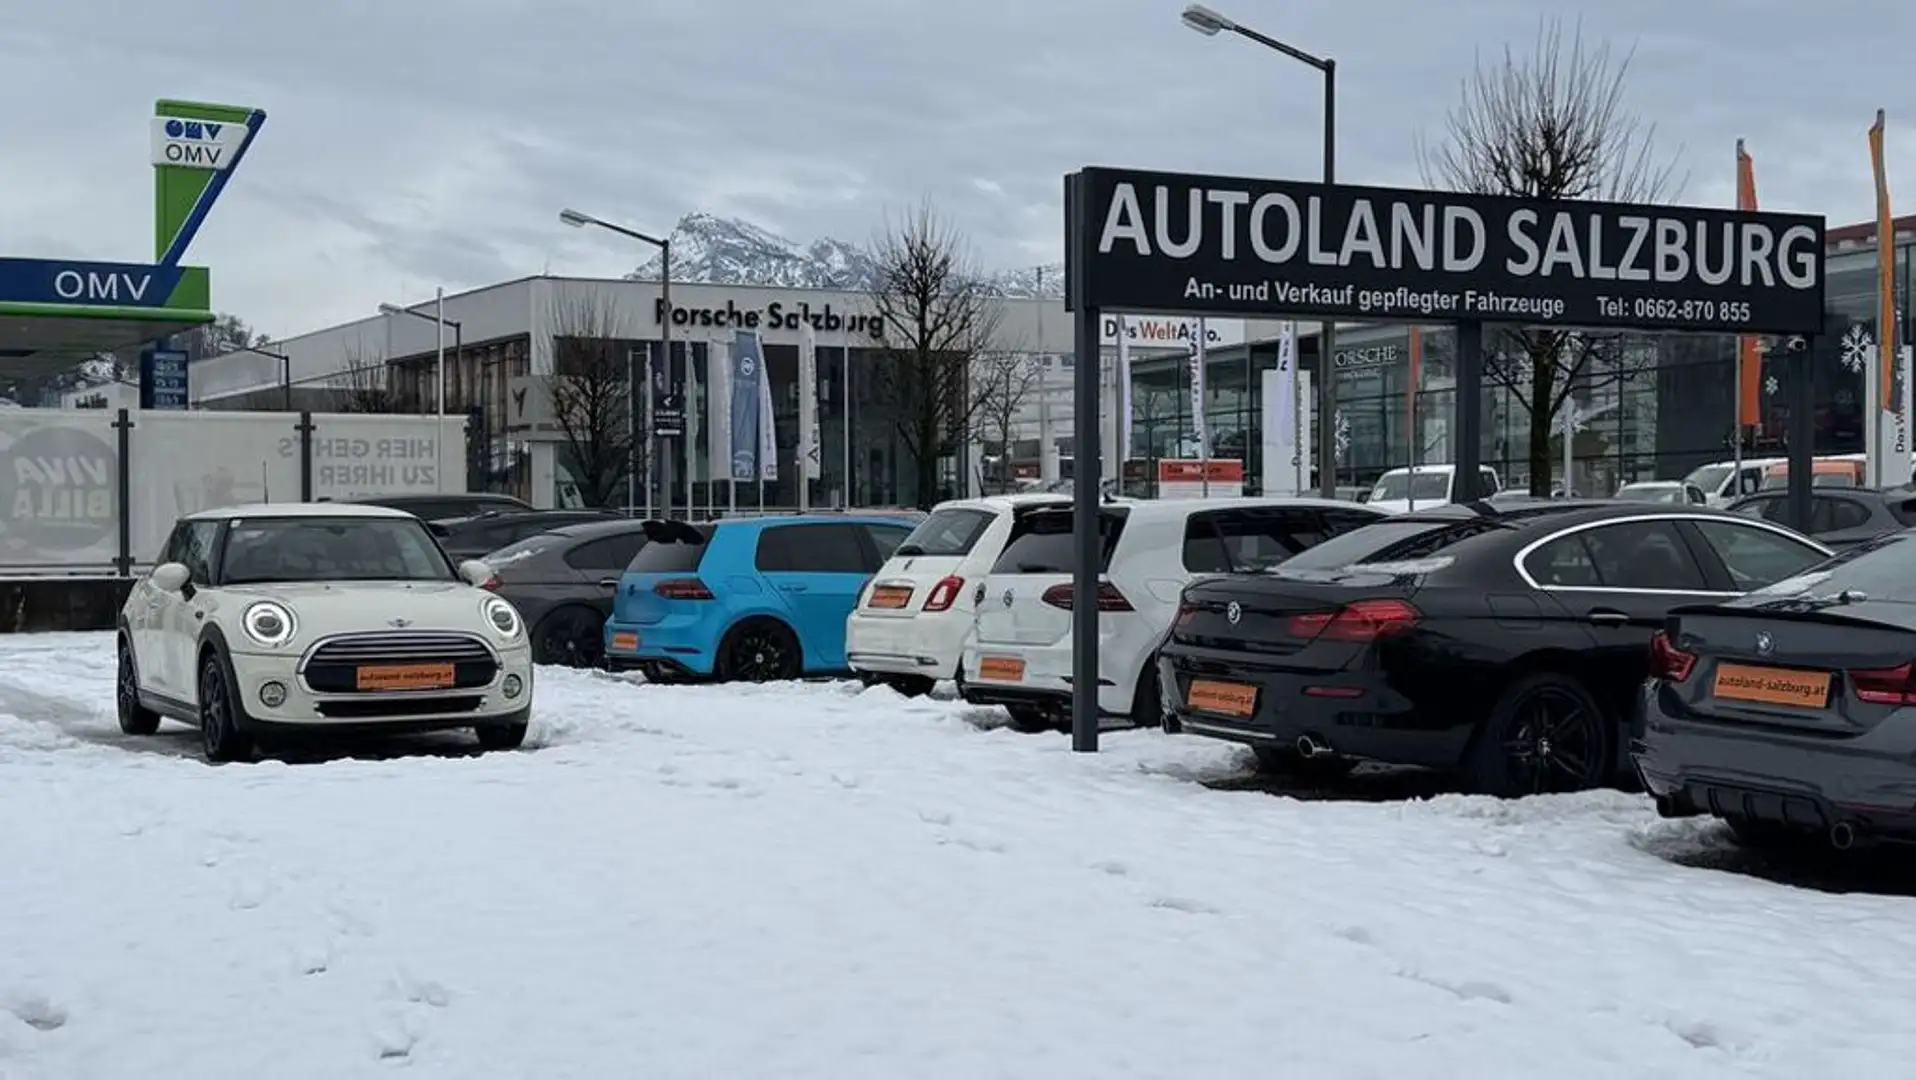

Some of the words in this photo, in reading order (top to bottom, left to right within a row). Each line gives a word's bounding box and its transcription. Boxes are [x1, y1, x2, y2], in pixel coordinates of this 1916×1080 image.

[166, 143, 222, 164] OMV
[1099, 183, 1487, 272] AUTOLAND
[1506, 208, 1817, 290] SALZBURG
[55, 270, 151, 300] OMV
[1184, 277, 1223, 299] An-
[1229, 281, 1269, 301] und
[1274, 282, 1354, 305] Verkauf
[1358, 286, 1460, 314] gepflegter
[1465, 291, 1564, 319] Fahrzeuge
[1597, 296, 1630, 317] Tel:
[1635, 298, 1714, 321] 0662-870
[1720, 302, 1751, 322] 855
[1718, 676, 1826, 697] autoland-salzburg.at
